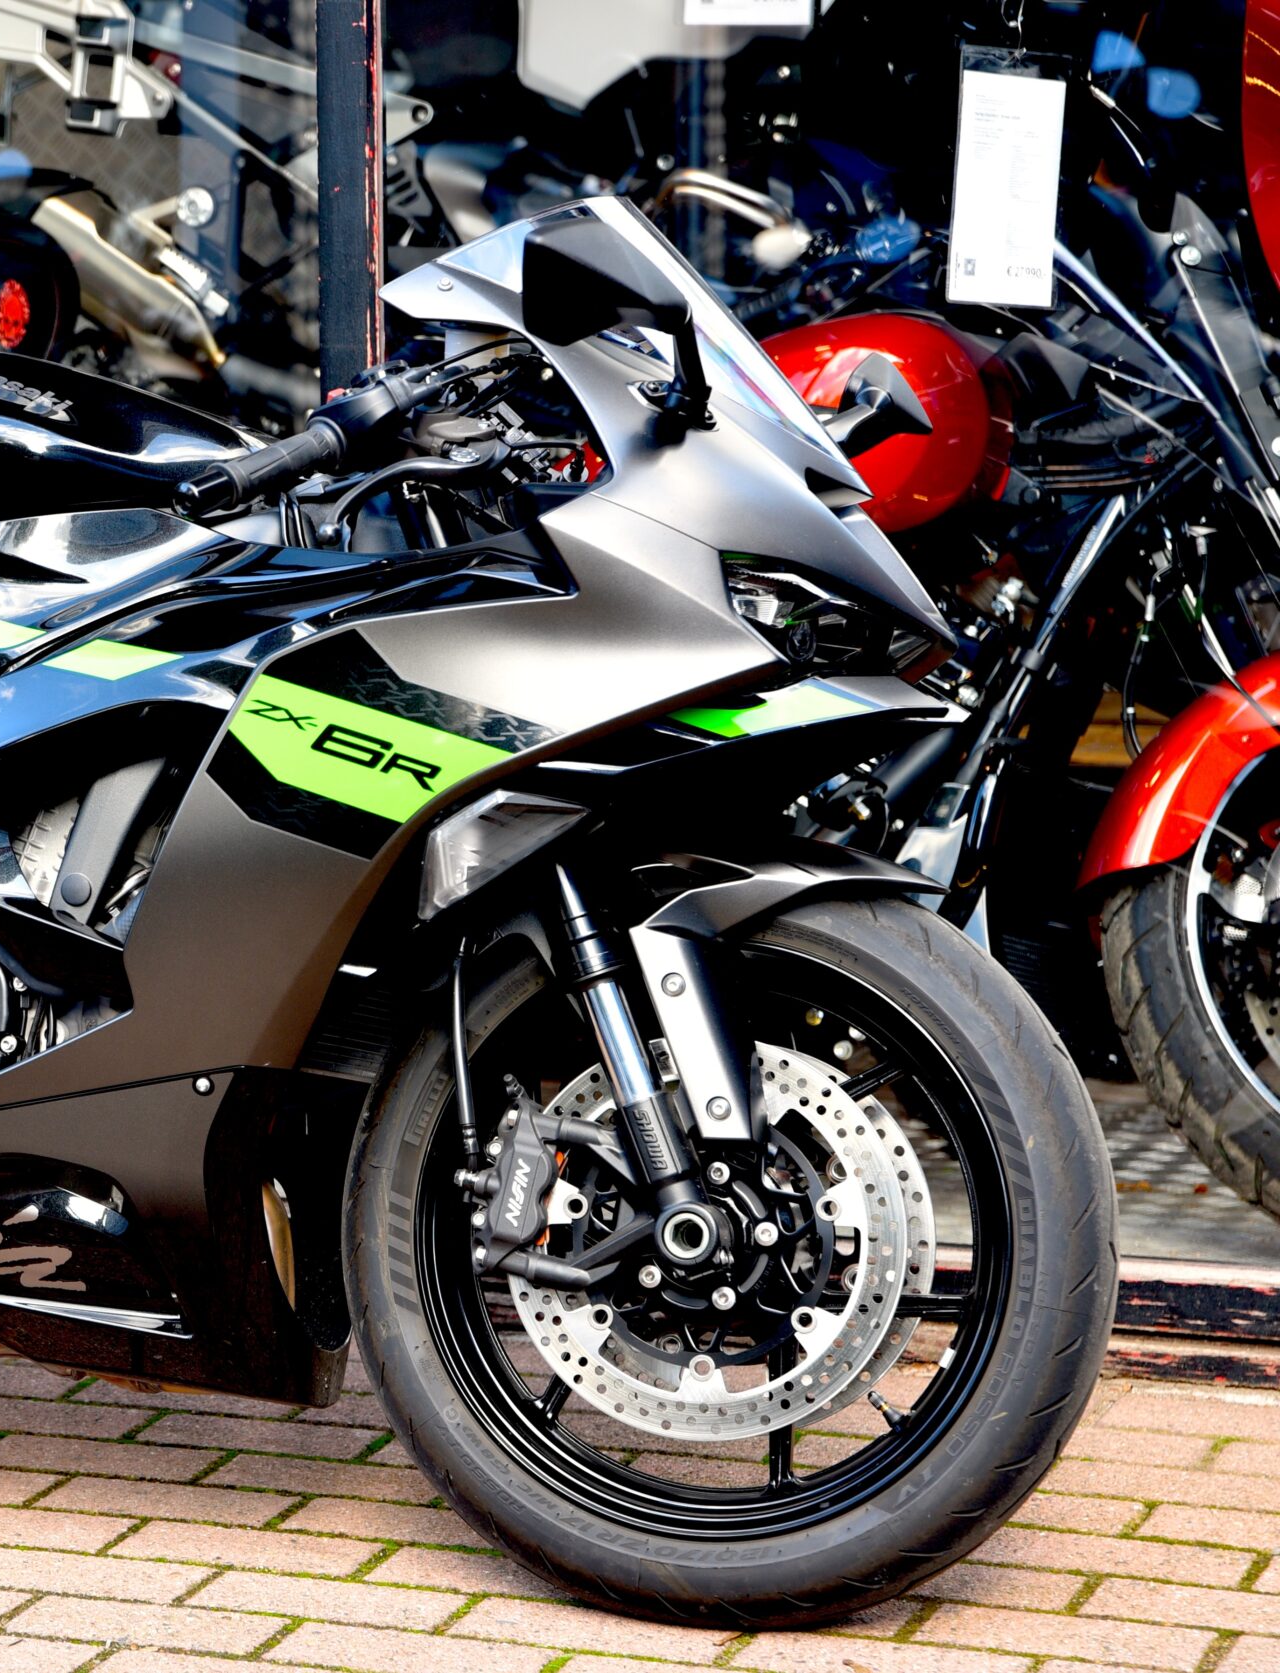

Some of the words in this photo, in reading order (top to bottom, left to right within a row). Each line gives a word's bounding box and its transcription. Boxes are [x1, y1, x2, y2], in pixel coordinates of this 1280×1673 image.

[244, 699, 442, 793] ZX-6R
[899, 986, 961, 1046] ROTATION
[631, 1109, 668, 1171] SHOWA
[1007, 1196, 1037, 1341] DIABLO
[944, 1350, 1016, 1458] ROSSO
[460, 1453, 528, 1513] ROSSO
[654, 1545, 771, 1562] 120/70
